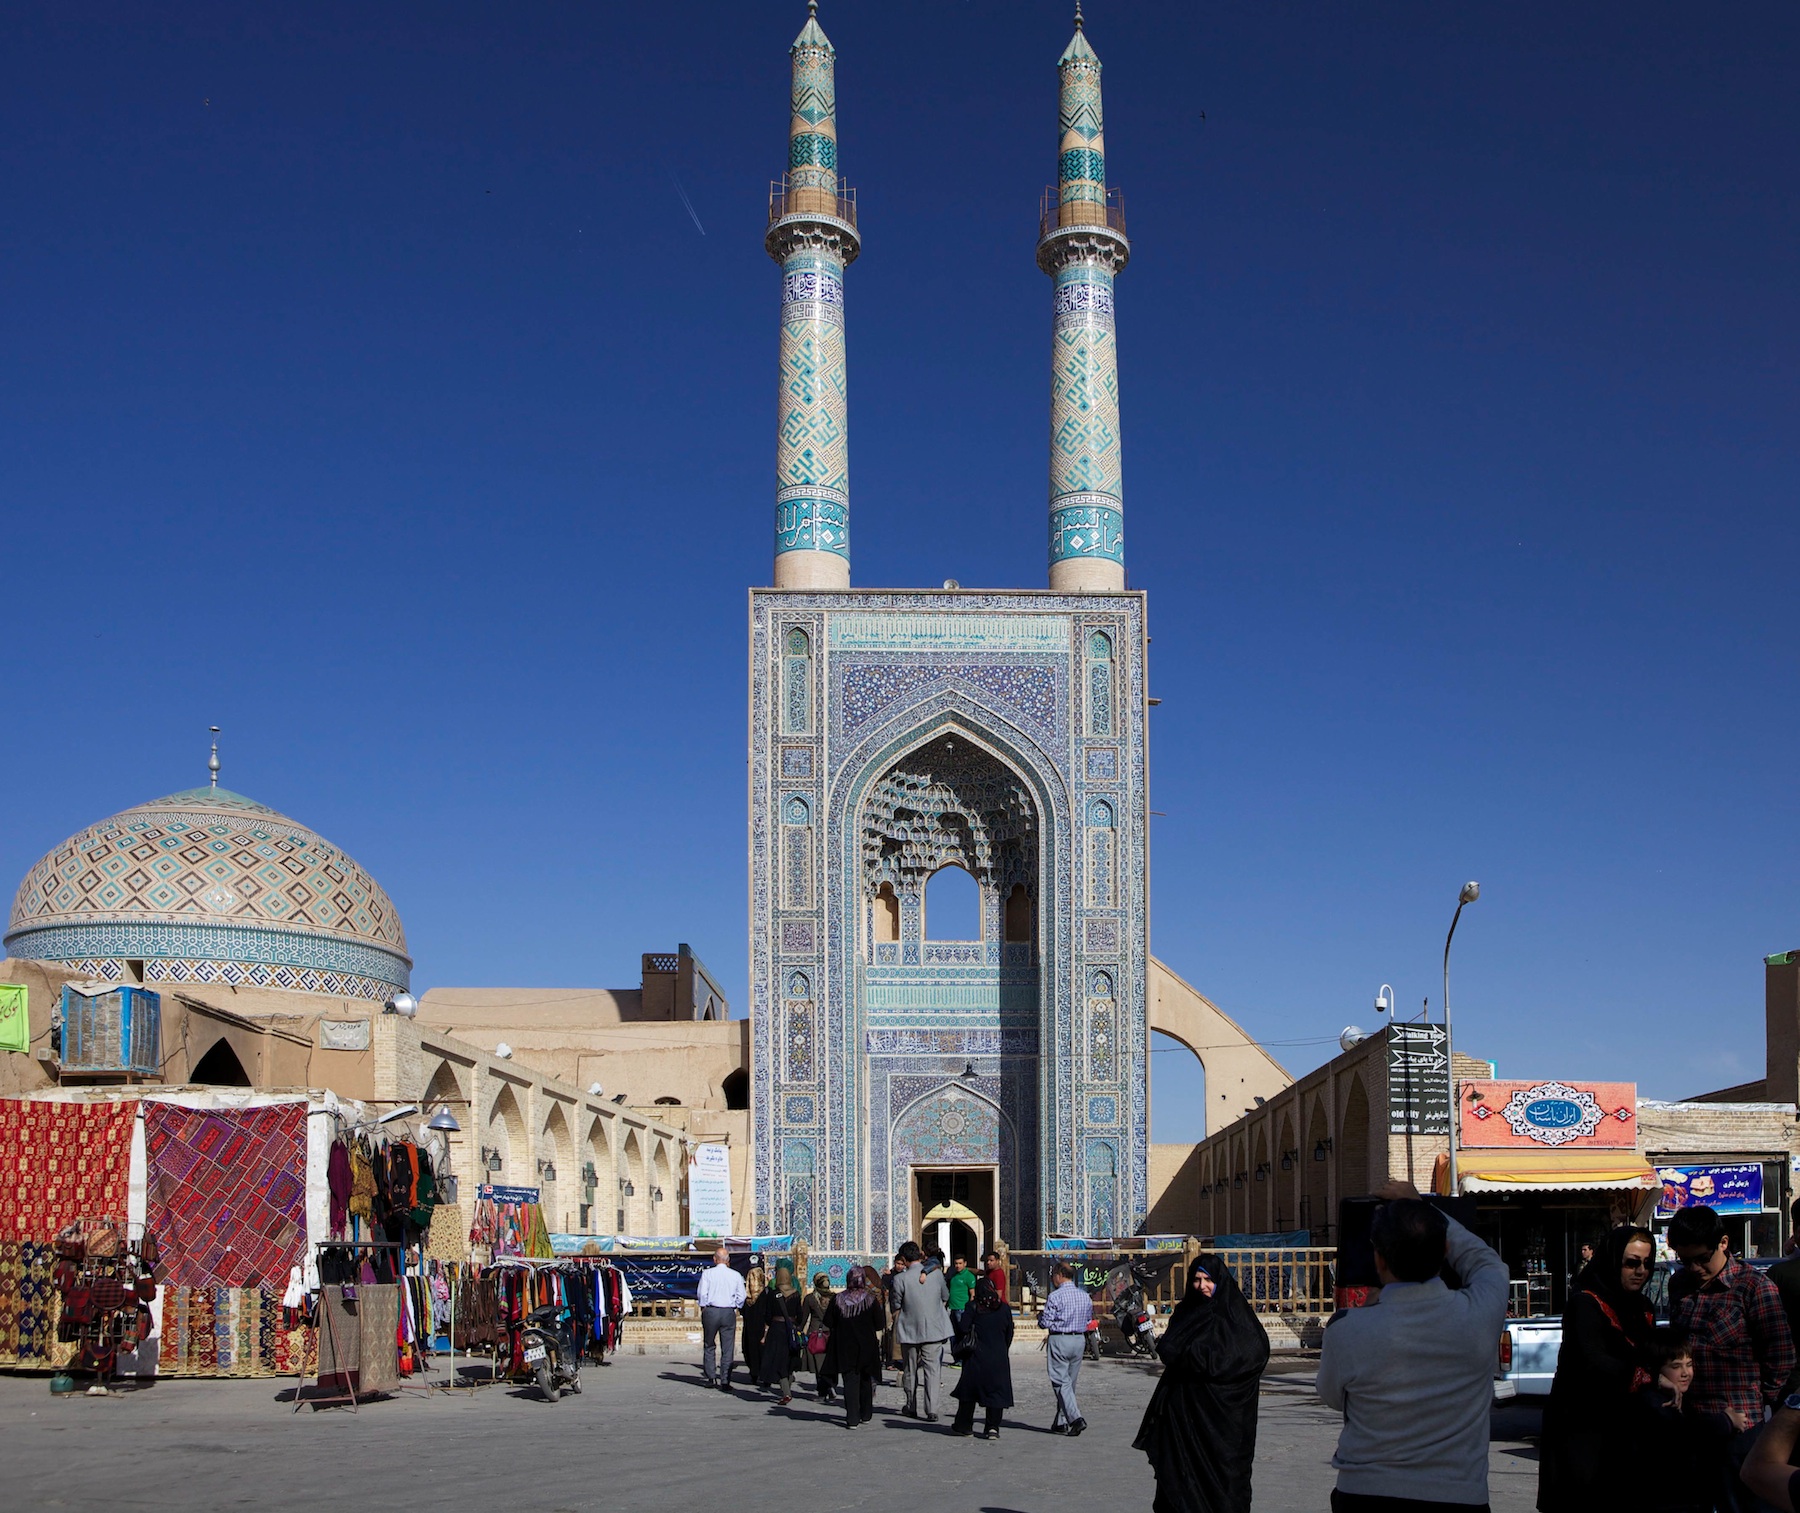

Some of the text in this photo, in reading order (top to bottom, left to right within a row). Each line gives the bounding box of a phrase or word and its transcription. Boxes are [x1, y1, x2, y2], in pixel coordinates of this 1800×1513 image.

[1391, 1110, 1420, 1119] old city
[1528, 1104, 1576, 1126] ایران باستان
[1156, 1241, 1183, 1250] برادران
